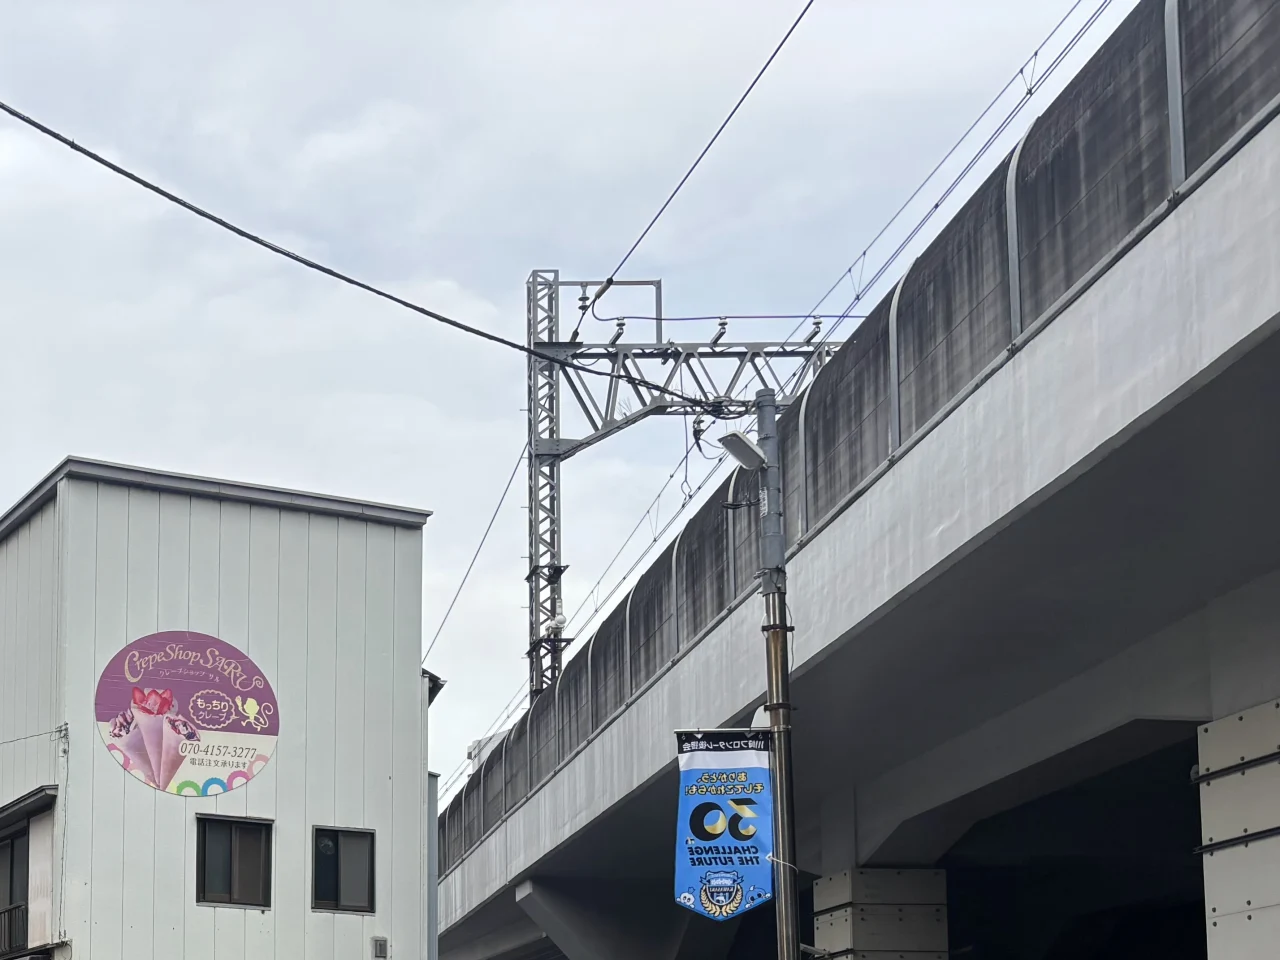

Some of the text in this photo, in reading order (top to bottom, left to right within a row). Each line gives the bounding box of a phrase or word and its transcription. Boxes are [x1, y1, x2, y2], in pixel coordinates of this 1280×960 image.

[196, 698, 229, 712] もっちり
[198, 711, 227, 721] クレープ
[180, 742, 257, 760] 070-4157-3277
[189, 757, 248, 770] 電話注文承ります
